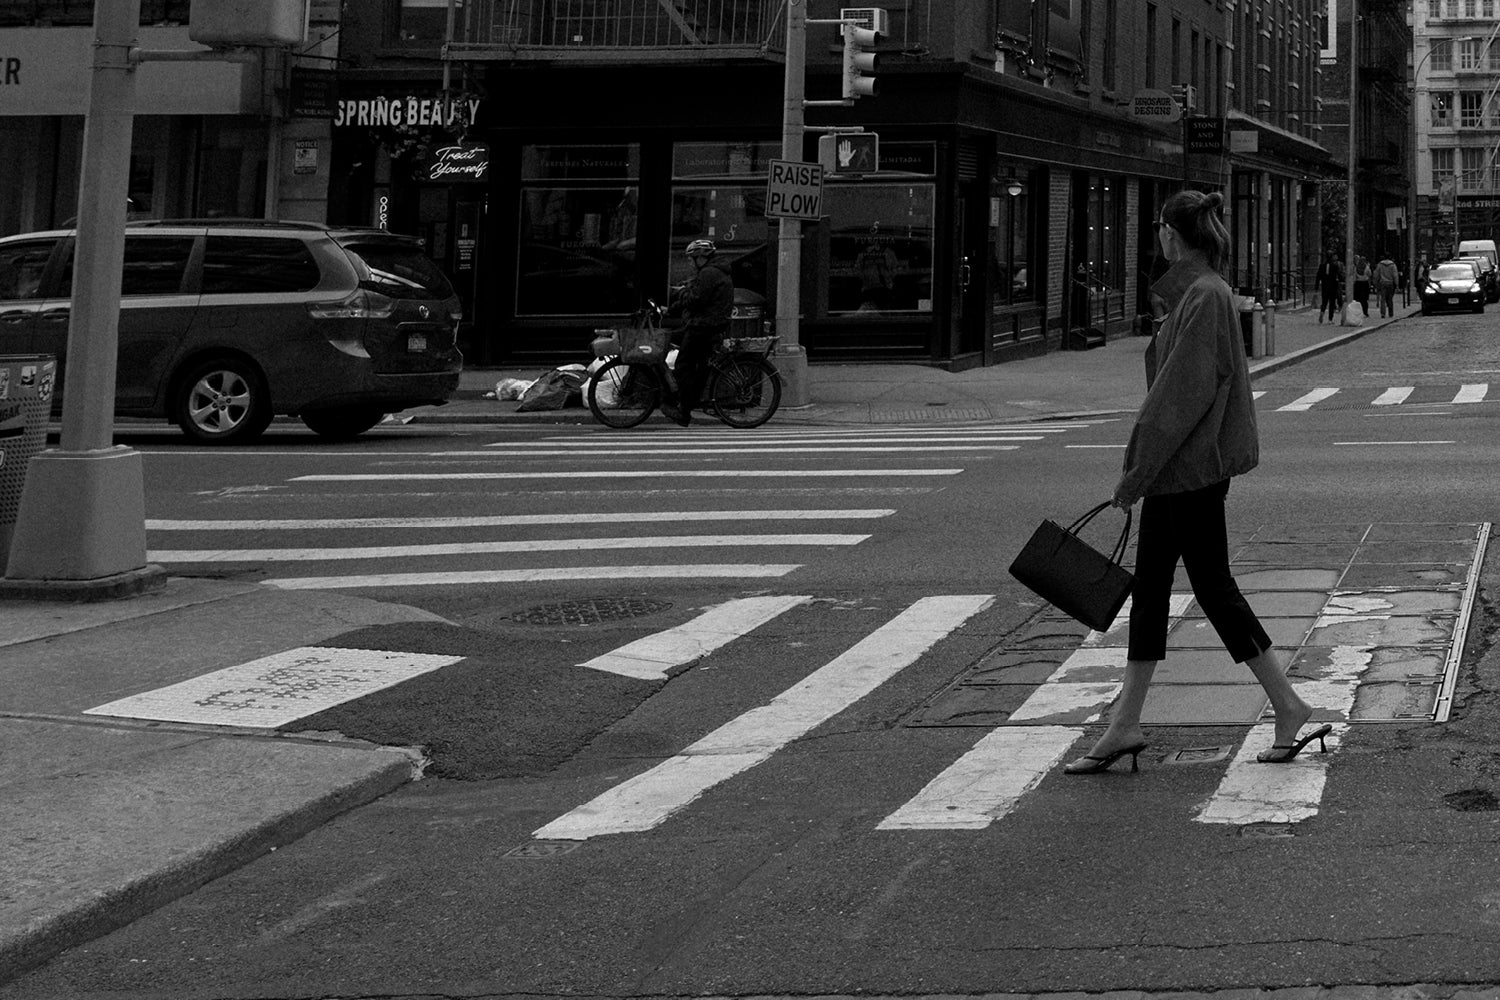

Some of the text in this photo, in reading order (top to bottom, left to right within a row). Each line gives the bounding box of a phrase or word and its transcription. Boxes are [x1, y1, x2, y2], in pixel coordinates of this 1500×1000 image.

[1134, 97, 1171, 106] DINOSAUR
[1134, 106, 1171, 115] DESIGNS
[334, 99, 480, 127] SPRING BEAUY
[435, 146, 486, 162] Treat
[429, 161, 489, 179] Yourself
[773, 165, 820, 187] RAISE
[770, 192, 819, 215] PLOW
